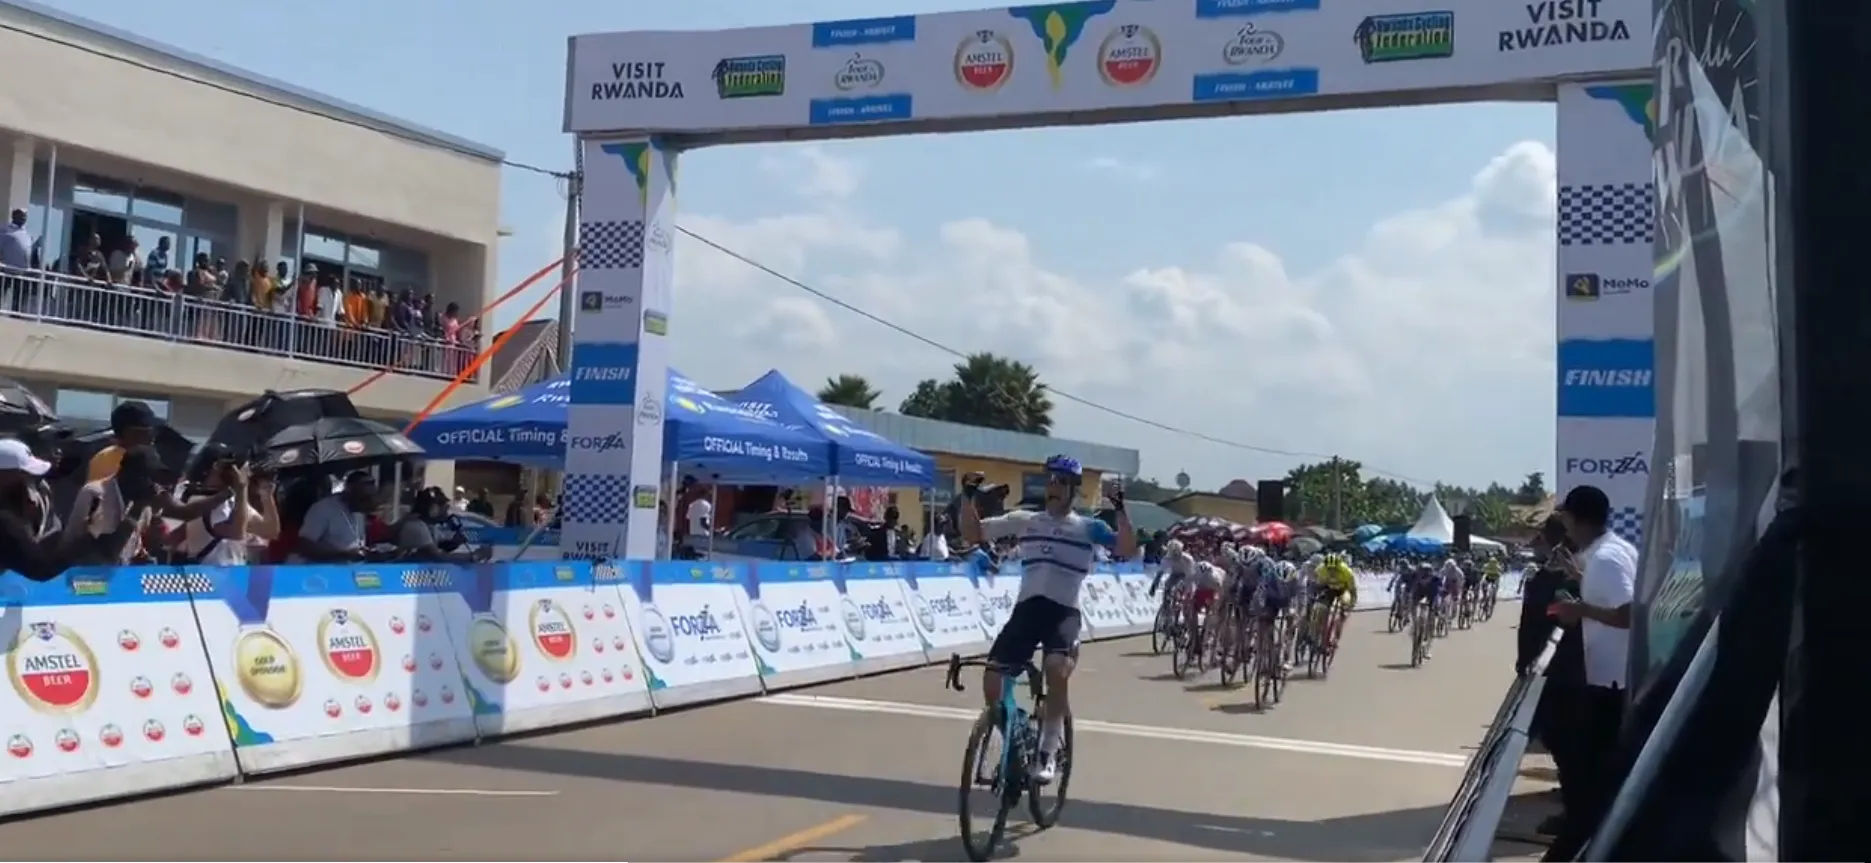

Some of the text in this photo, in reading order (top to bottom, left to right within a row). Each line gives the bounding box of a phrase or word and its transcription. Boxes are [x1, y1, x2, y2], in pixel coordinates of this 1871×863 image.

[1526, 0, 1600, 24] VISIT
[1499, 20, 1630, 51] RWANDA
[964, 52, 1004, 63] AMSTEL
[1109, 47, 1149, 59] AMSTEL
[612, 62, 666, 80] VISIT
[591, 82, 685, 101] RWANDA
[1603, 277, 1649, 290] MoMo
[575, 366, 631, 380] FINISH
[1564, 369, 1652, 387] FINISH
[437, 428, 504, 446] OFFICIAL
[508, 426, 555, 447] Timing
[704, 436, 744, 455] OFFICIAL
[745, 441, 773, 461] Timing
[576, 541, 609, 552] VISIT
[329, 636, 366, 649] AMSTEL
[24, 653, 82, 671] AMSTEL
[42, 674, 73, 686] BEER
